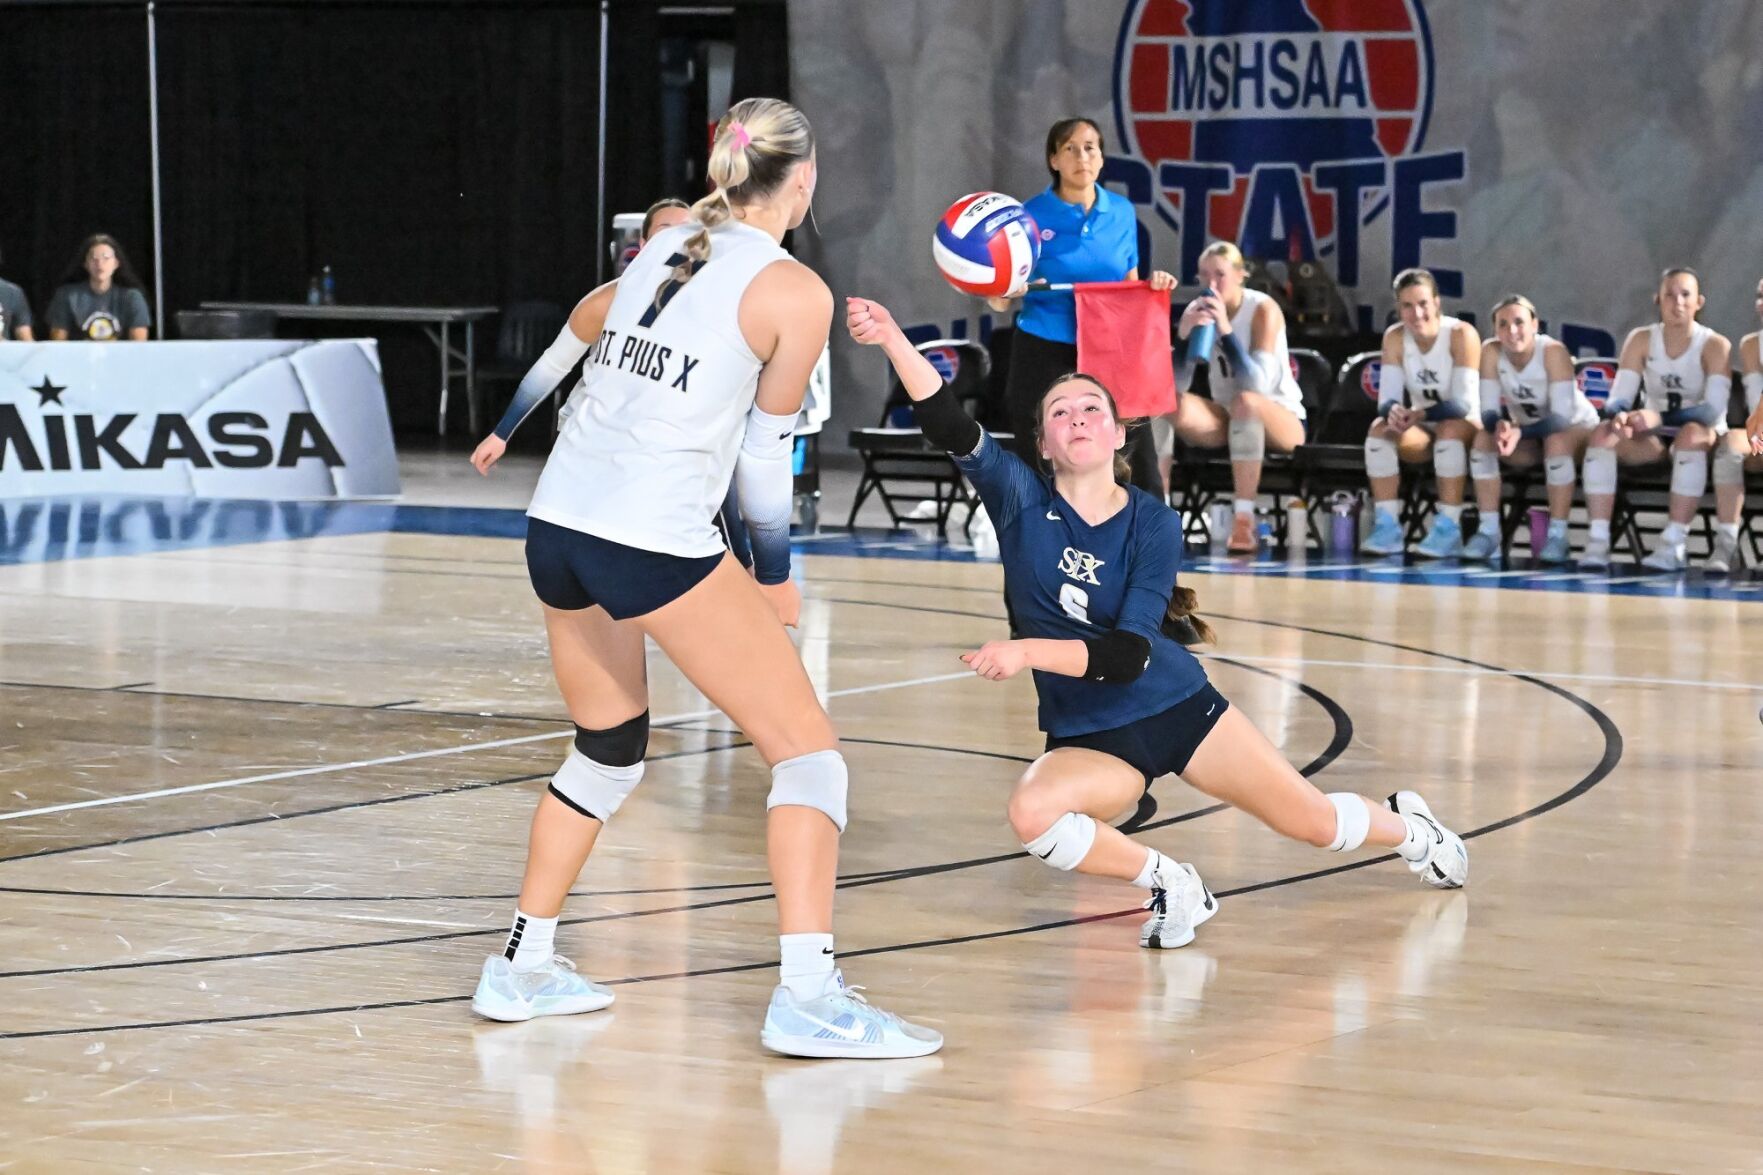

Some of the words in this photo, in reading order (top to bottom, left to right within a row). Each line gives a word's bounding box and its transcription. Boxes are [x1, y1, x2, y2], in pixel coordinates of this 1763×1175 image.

[1170, 39, 1367, 110] MSHSAA
[637, 252, 708, 329] 7
[618, 335, 673, 382] PIUS
[671, 354, 700, 393] X
